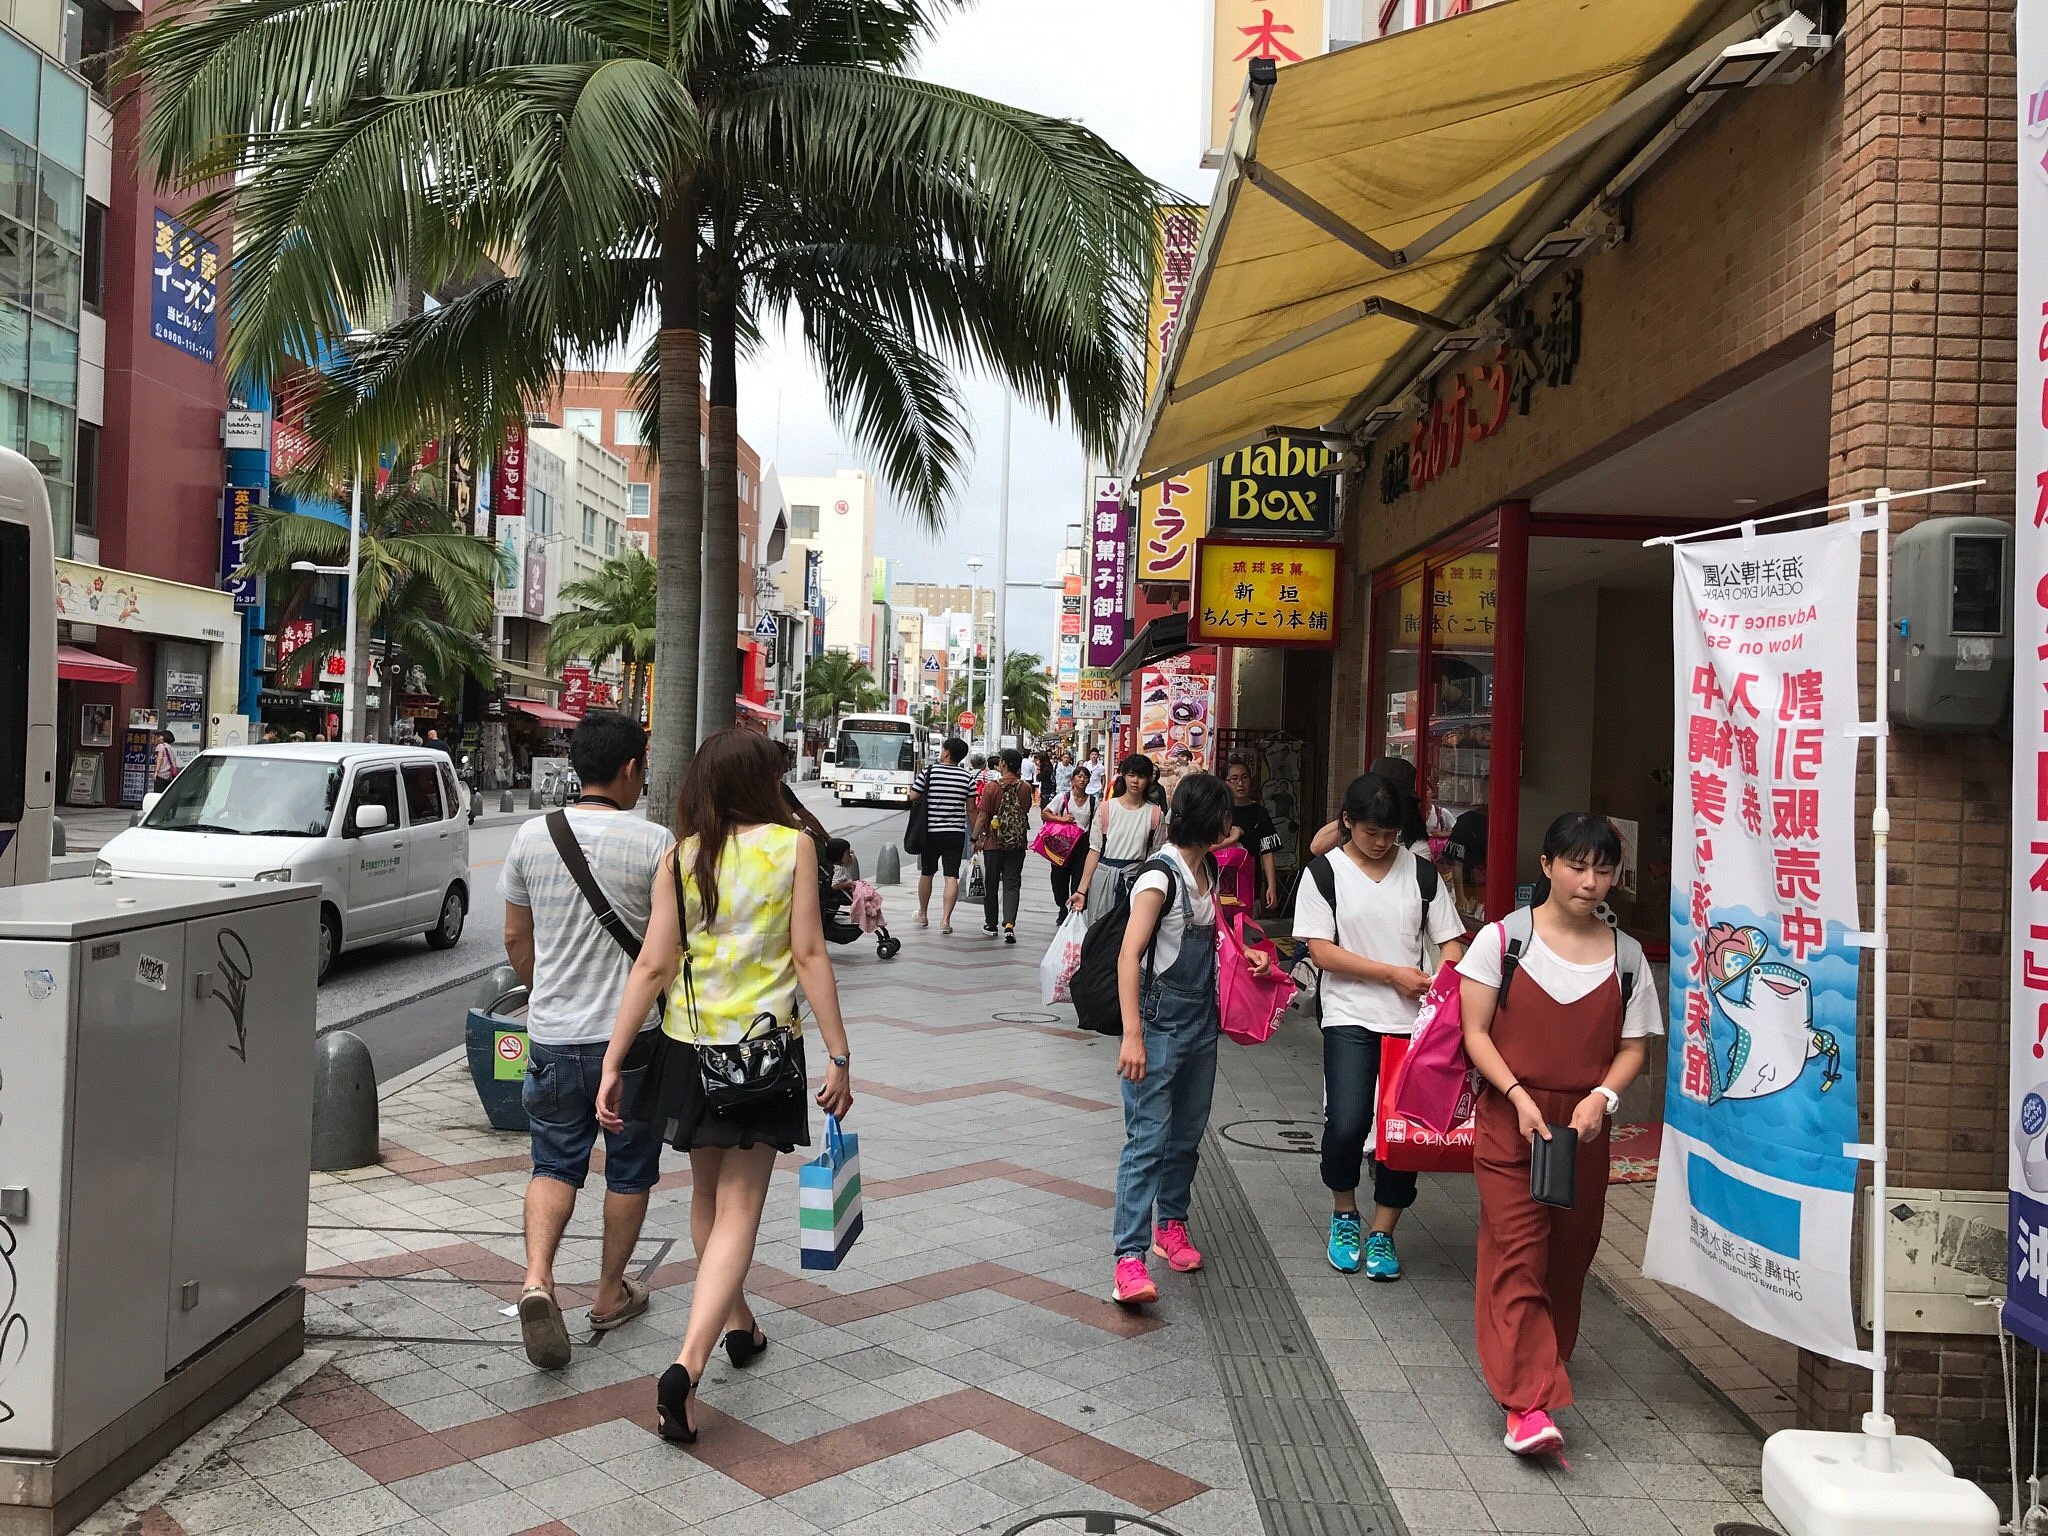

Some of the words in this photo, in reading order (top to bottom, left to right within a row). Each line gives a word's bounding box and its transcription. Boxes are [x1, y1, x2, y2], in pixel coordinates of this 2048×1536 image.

[155, 267, 215, 313] イーオン
[1149, 471, 1190, 572] トラン
[1092, 512, 1118, 646] 御菓子御殿
[1233, 561, 1304, 576] 琉球銘菓
[1234, 582, 1300, 603] 新垣
[1204, 608, 1329, 631] ちんすこう本舗
[1081, 690, 1107, 701] 2960
[1413, 1131, 1475, 1147] OKINAW
